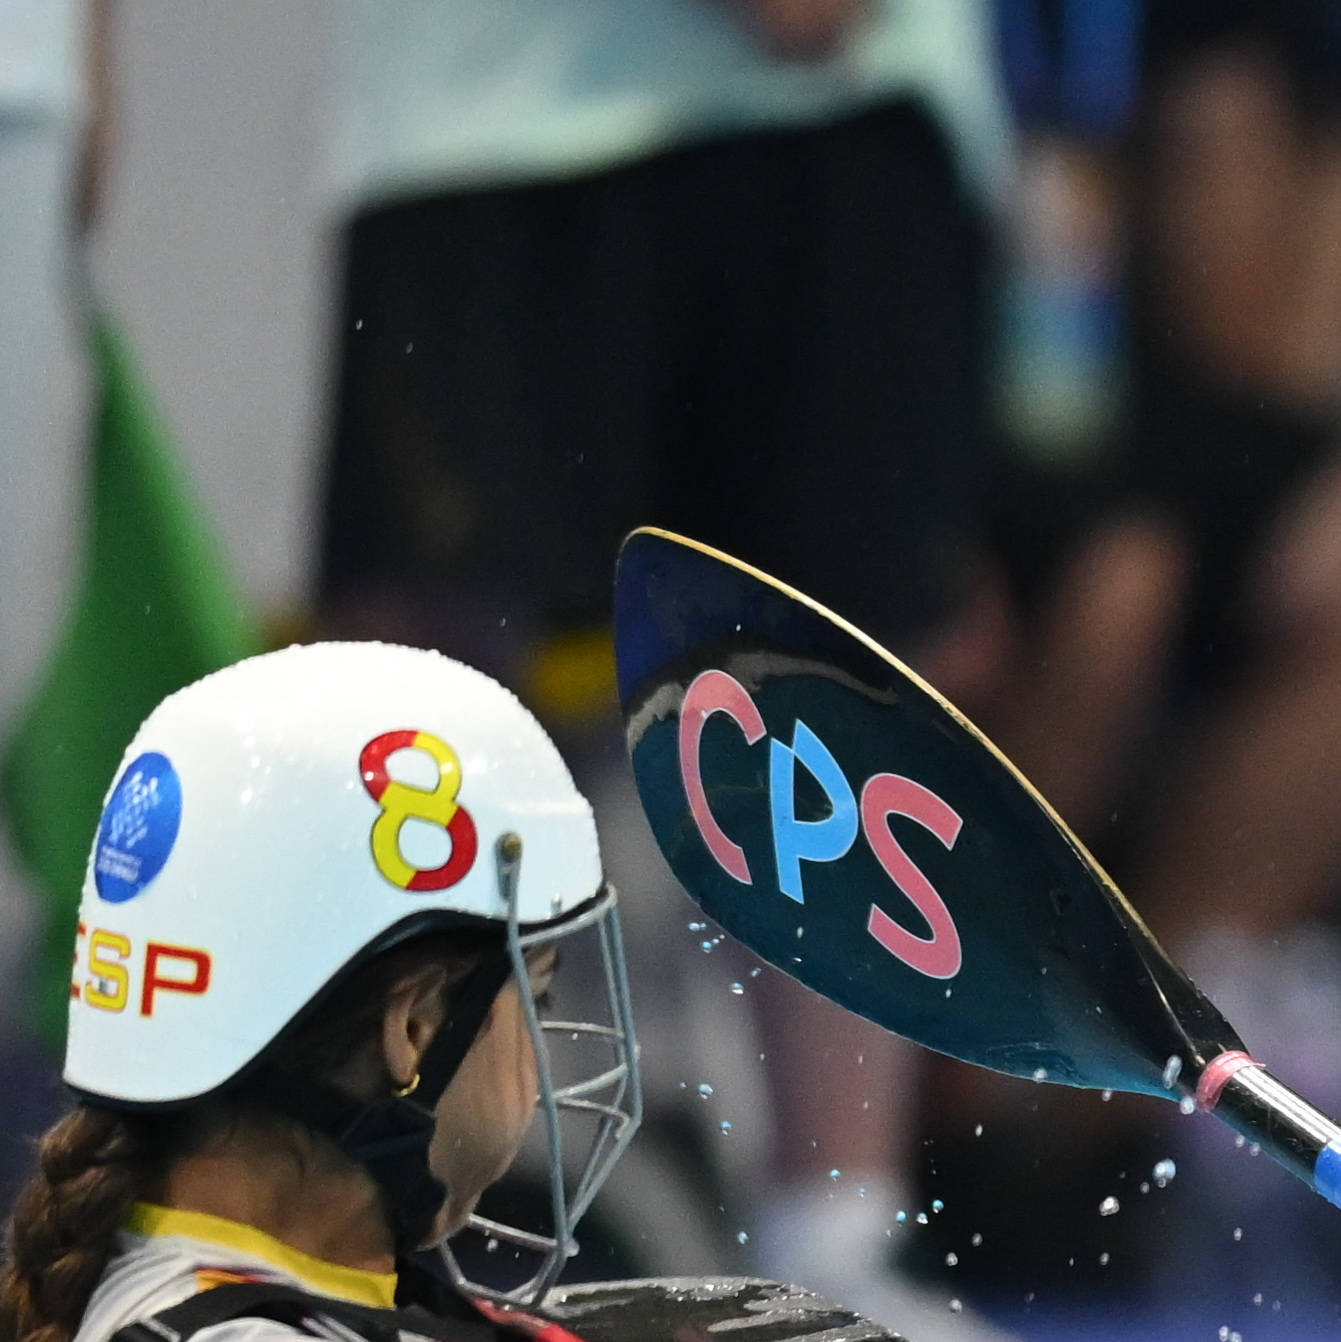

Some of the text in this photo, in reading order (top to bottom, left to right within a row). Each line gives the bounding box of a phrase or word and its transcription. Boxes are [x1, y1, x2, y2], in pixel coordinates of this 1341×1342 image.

[358, 728, 478, 892] 8
[678, 668, 963, 980] CPS
[70, 922, 215, 1019] SP
